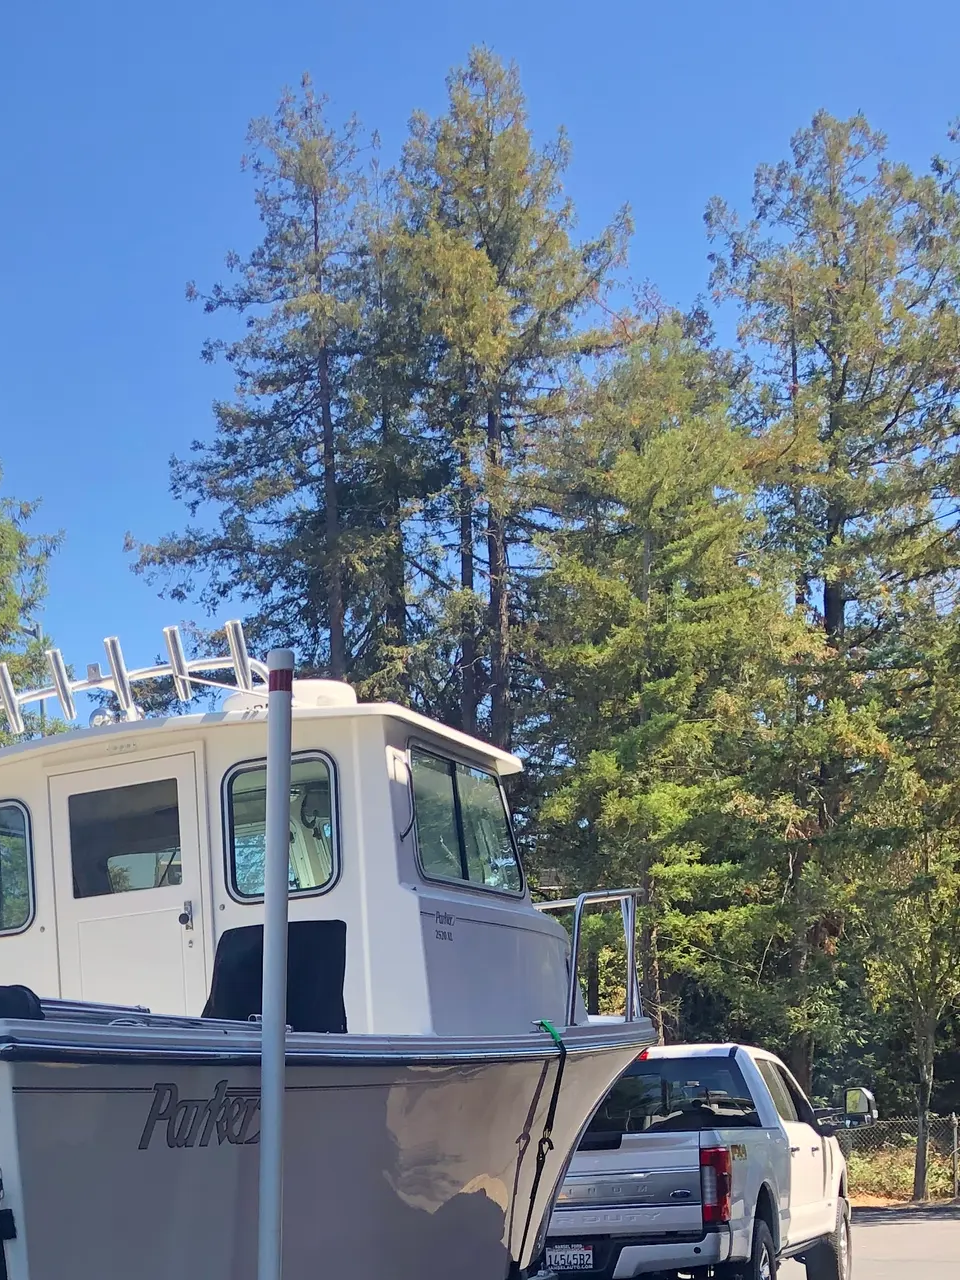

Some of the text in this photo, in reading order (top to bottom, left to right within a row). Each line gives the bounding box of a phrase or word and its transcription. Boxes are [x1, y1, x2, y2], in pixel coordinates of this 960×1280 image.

[435, 911, 455, 926] Parker
[138, 1080, 261, 1150] Parker
[568, 1186, 648, 1195] INUM
[582, 1211, 660, 1223] DUTY
[548, 1253, 591, 1266] 14545B2
